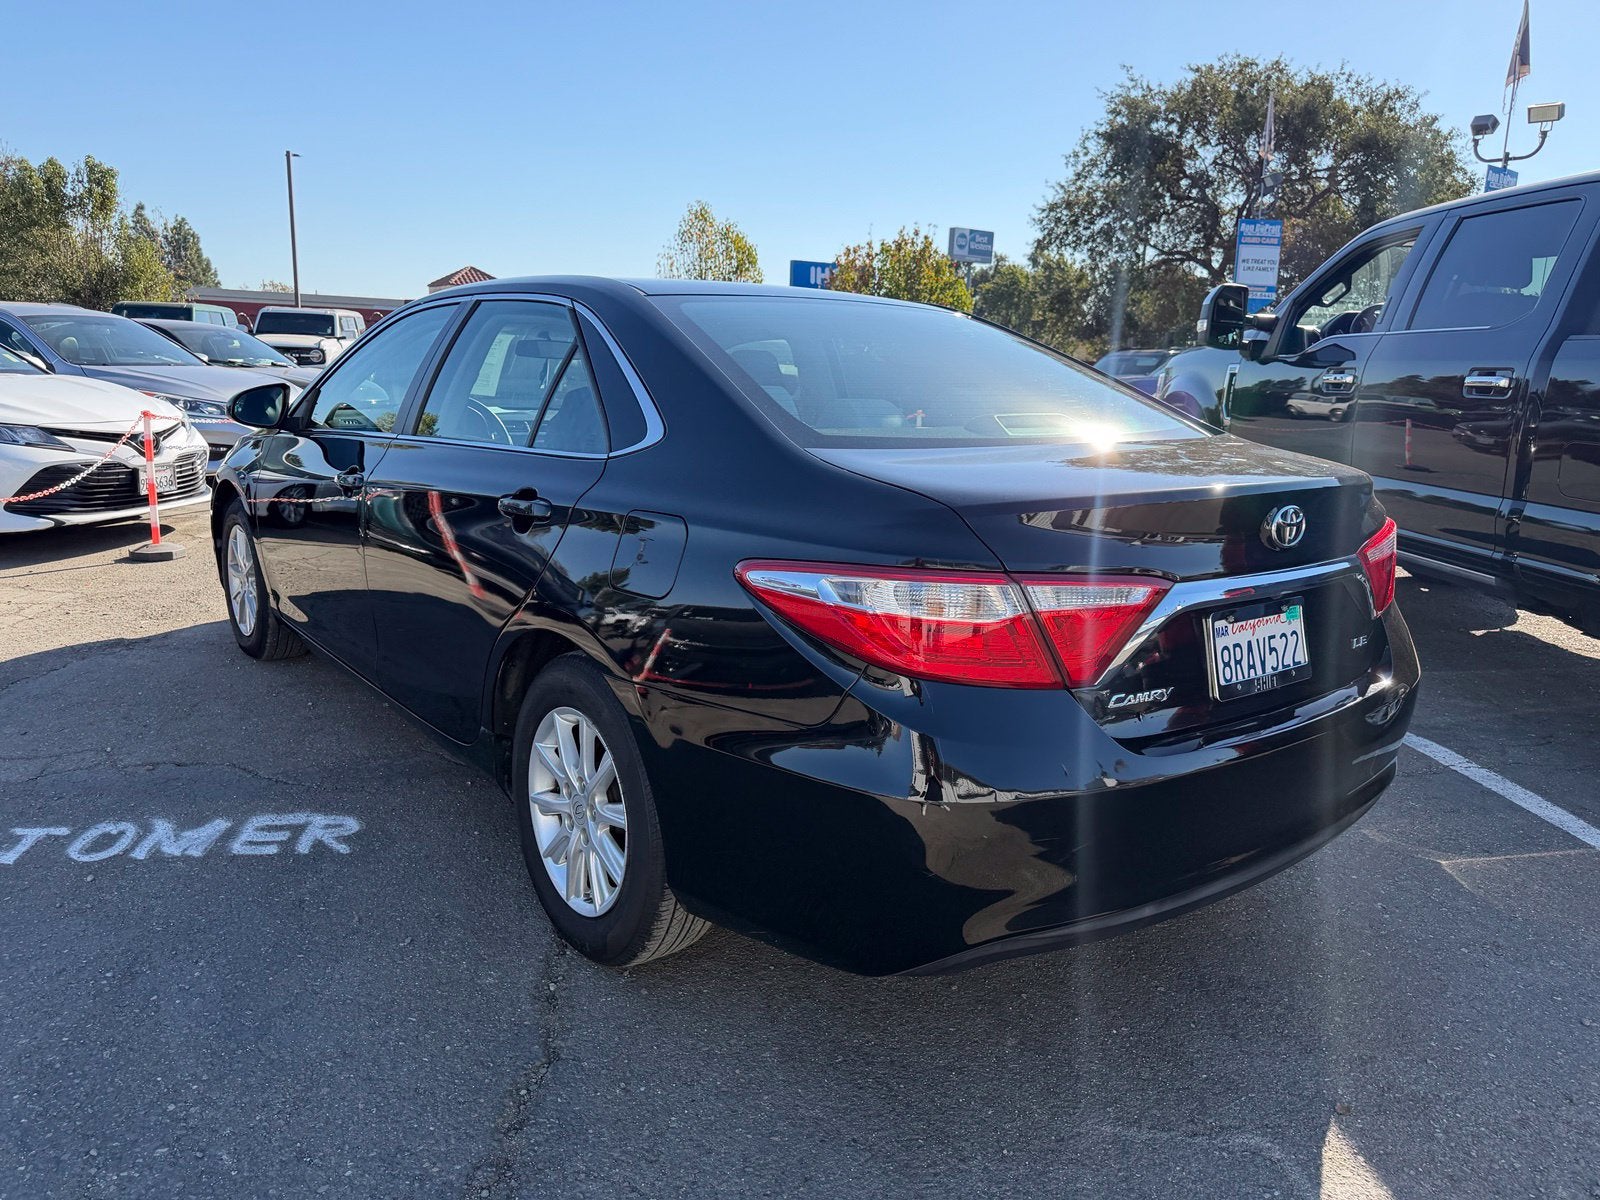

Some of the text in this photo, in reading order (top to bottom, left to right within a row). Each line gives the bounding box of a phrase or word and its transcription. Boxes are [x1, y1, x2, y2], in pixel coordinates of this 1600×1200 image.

[969, 241, 992, 251] Western
[975, 235, 988, 243] Best
[1215, 626, 1230, 639] MAR
[1352, 634, 1368, 649] LE
[1220, 629, 1302, 684] 8RAV522
[1108, 686, 1175, 709] CAMRY
[0, 812, 362, 865] TOMER
